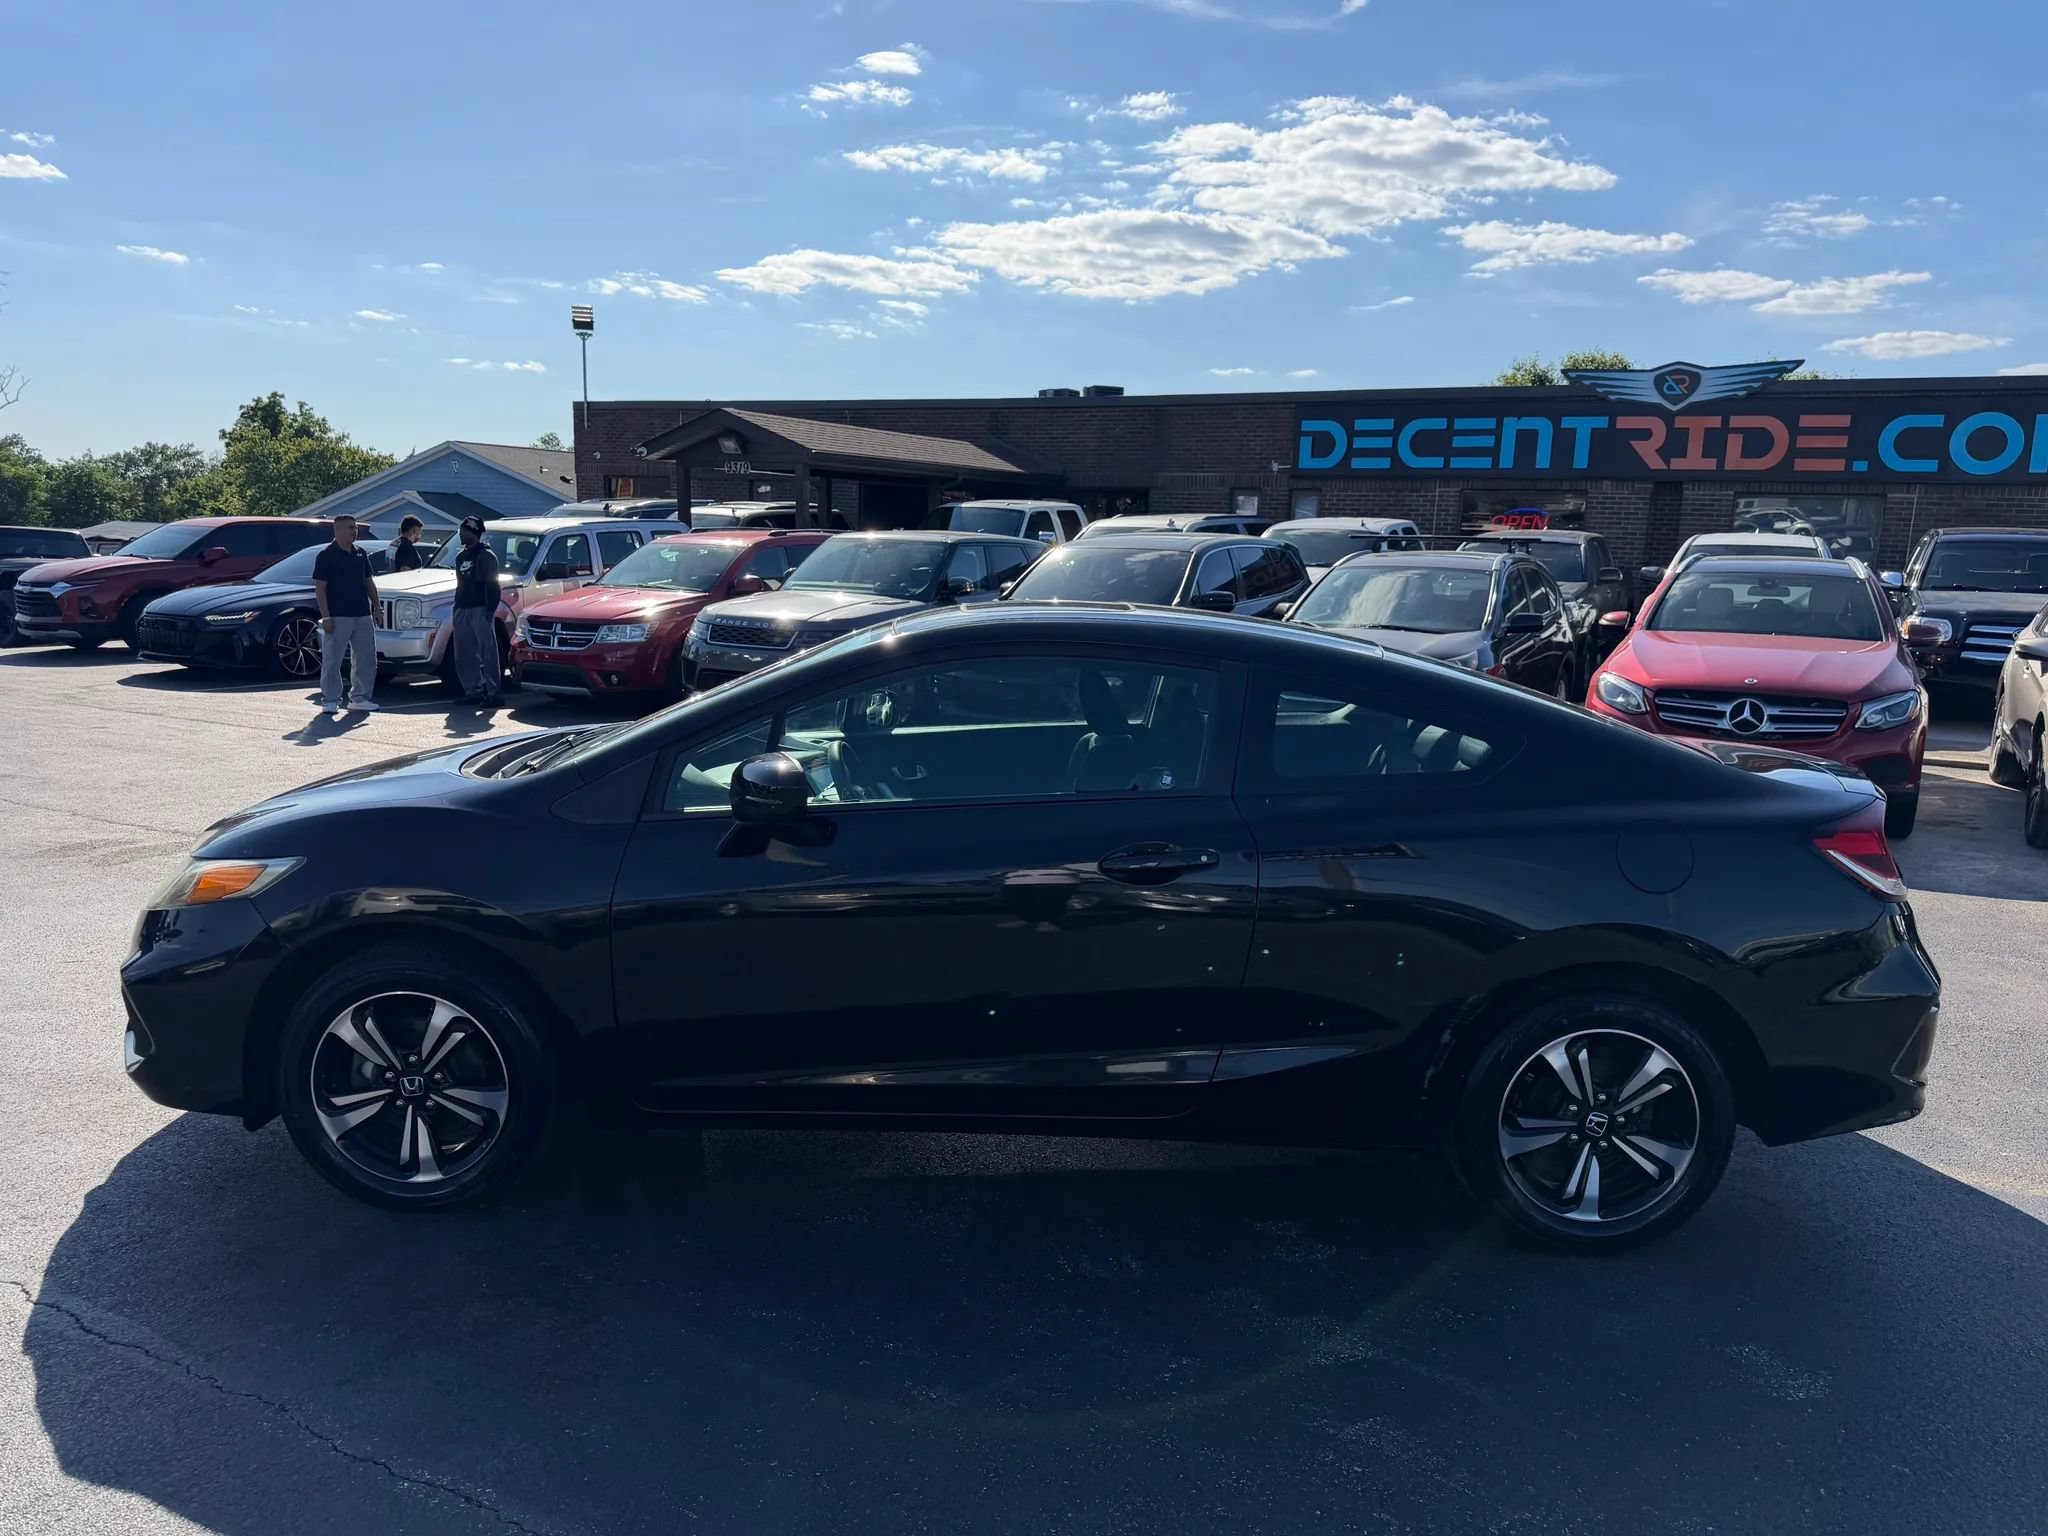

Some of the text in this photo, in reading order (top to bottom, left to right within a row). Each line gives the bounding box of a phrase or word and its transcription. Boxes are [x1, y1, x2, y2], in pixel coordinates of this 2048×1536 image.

[1298, 412, 2048, 475] DECENTRIDE.CO
[1491, 514, 1550, 530] OPEN
[715, 618, 795, 630] RANGE ROV
